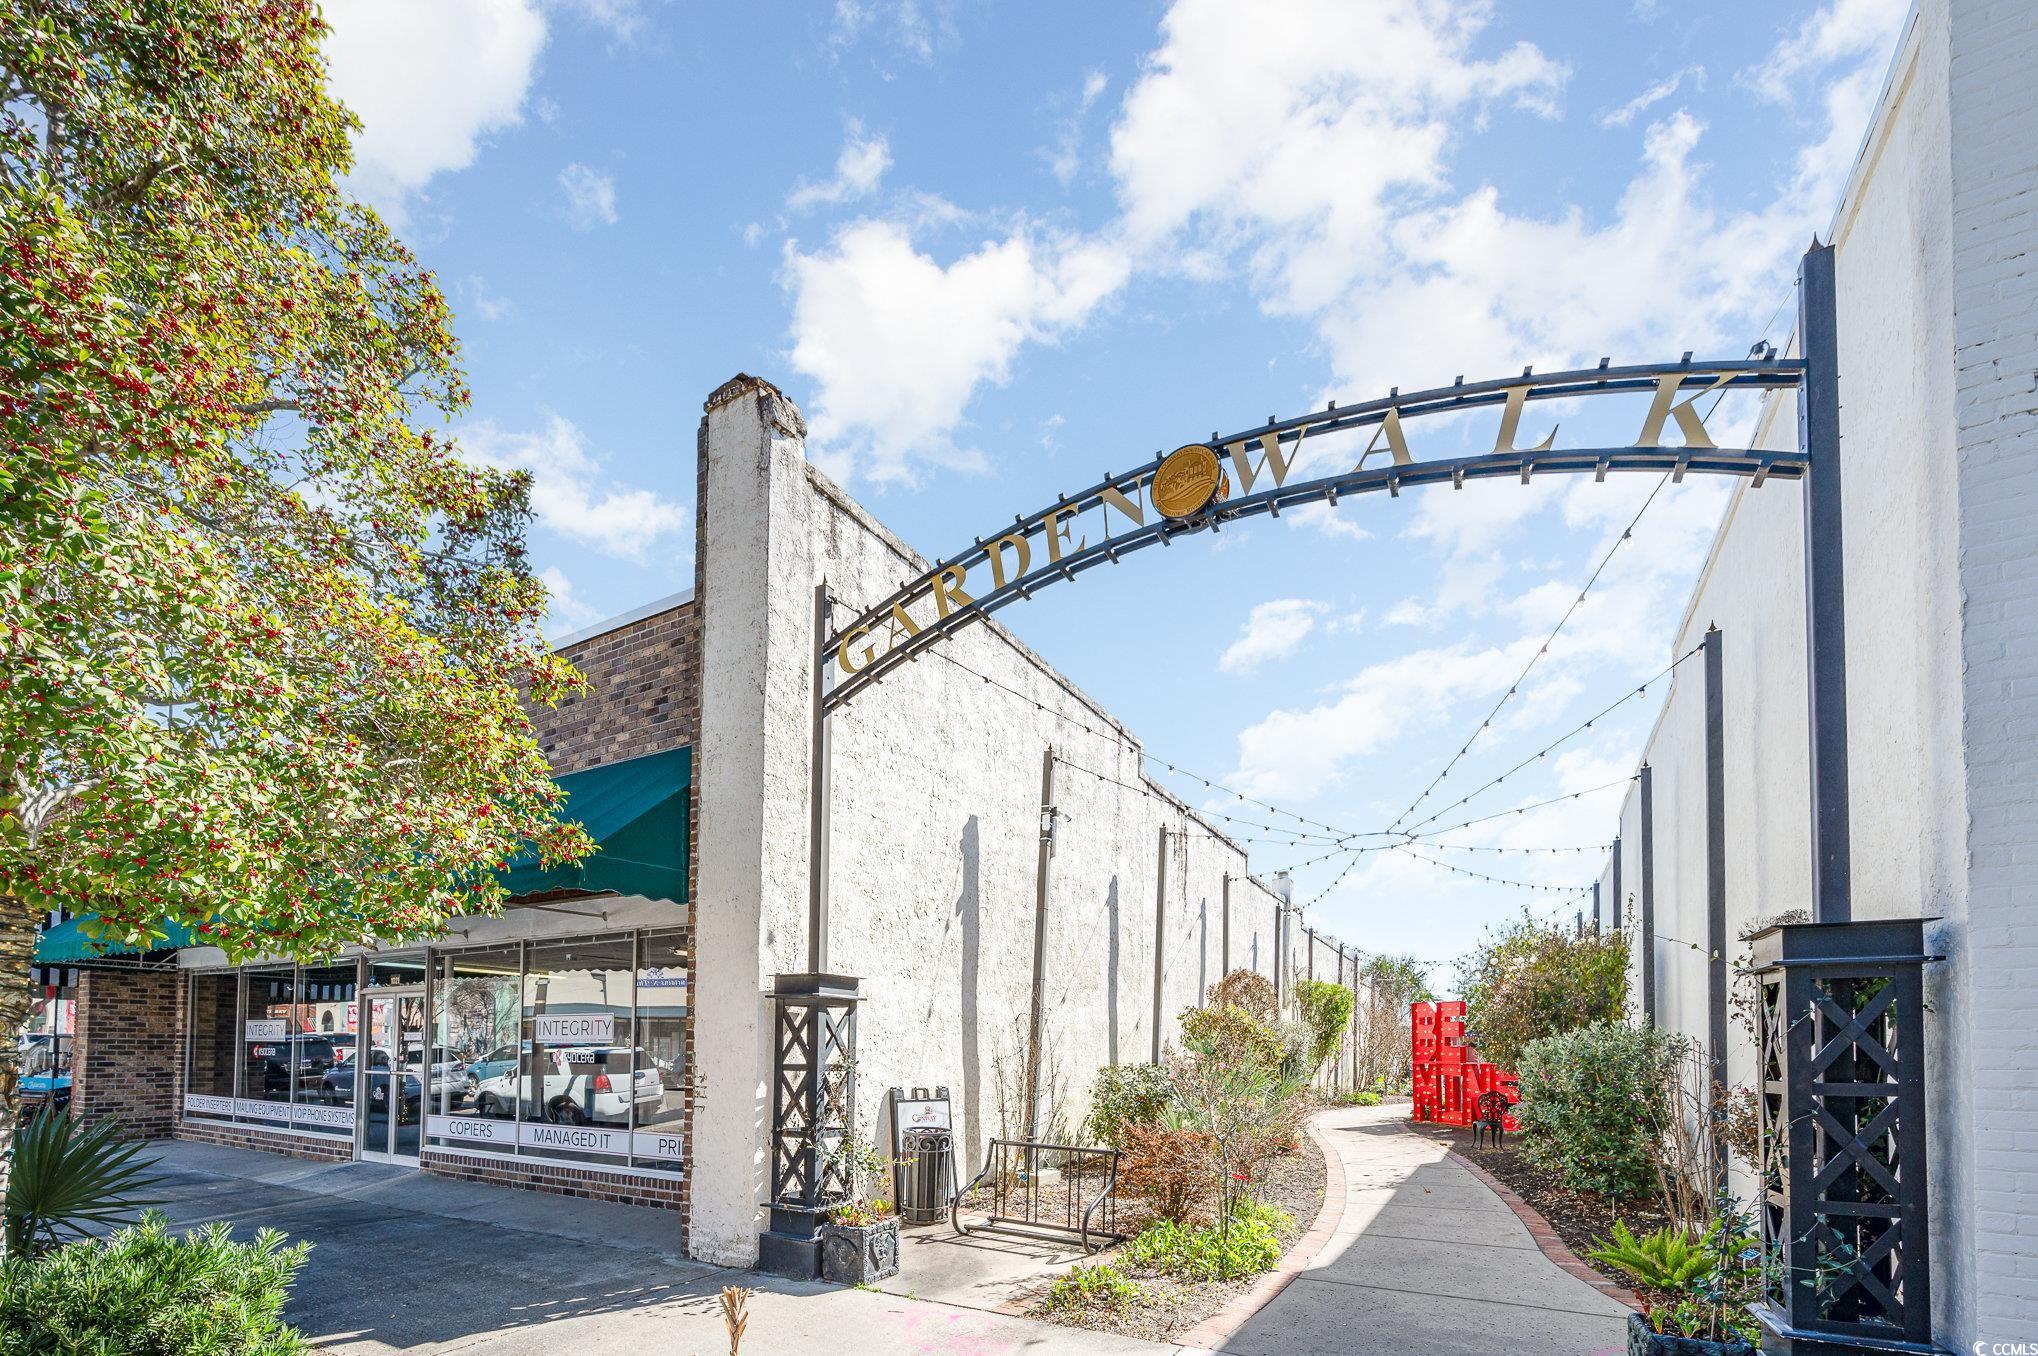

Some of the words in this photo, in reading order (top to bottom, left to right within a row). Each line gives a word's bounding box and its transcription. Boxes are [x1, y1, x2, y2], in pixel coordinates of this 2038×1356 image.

[838, 473, 1145, 674] GARDEN
[1225, 370, 1749, 496] WALK
[246, 1024, 286, 1036] INTEGRITY
[538, 1019, 612, 1037] INTEGRITY
[1411, 1001, 1467, 1063] BE
[187, 1097, 206, 1109] FOLDER
[206, 1099, 232, 1112] INSERTERS
[1412, 1062, 1523, 1132] MINE
[236, 1102, 258, 1115] MAILING
[258, 1104, 290, 1118] EQUIPMENT
[307, 1108, 327, 1122] PHONE
[328, 1110, 355, 1125] SYSTEMS
[449, 1121, 493, 1138] COPIERS
[533, 1128, 597, 1148] MANAGED
[600, 1133, 612, 1149] IT
